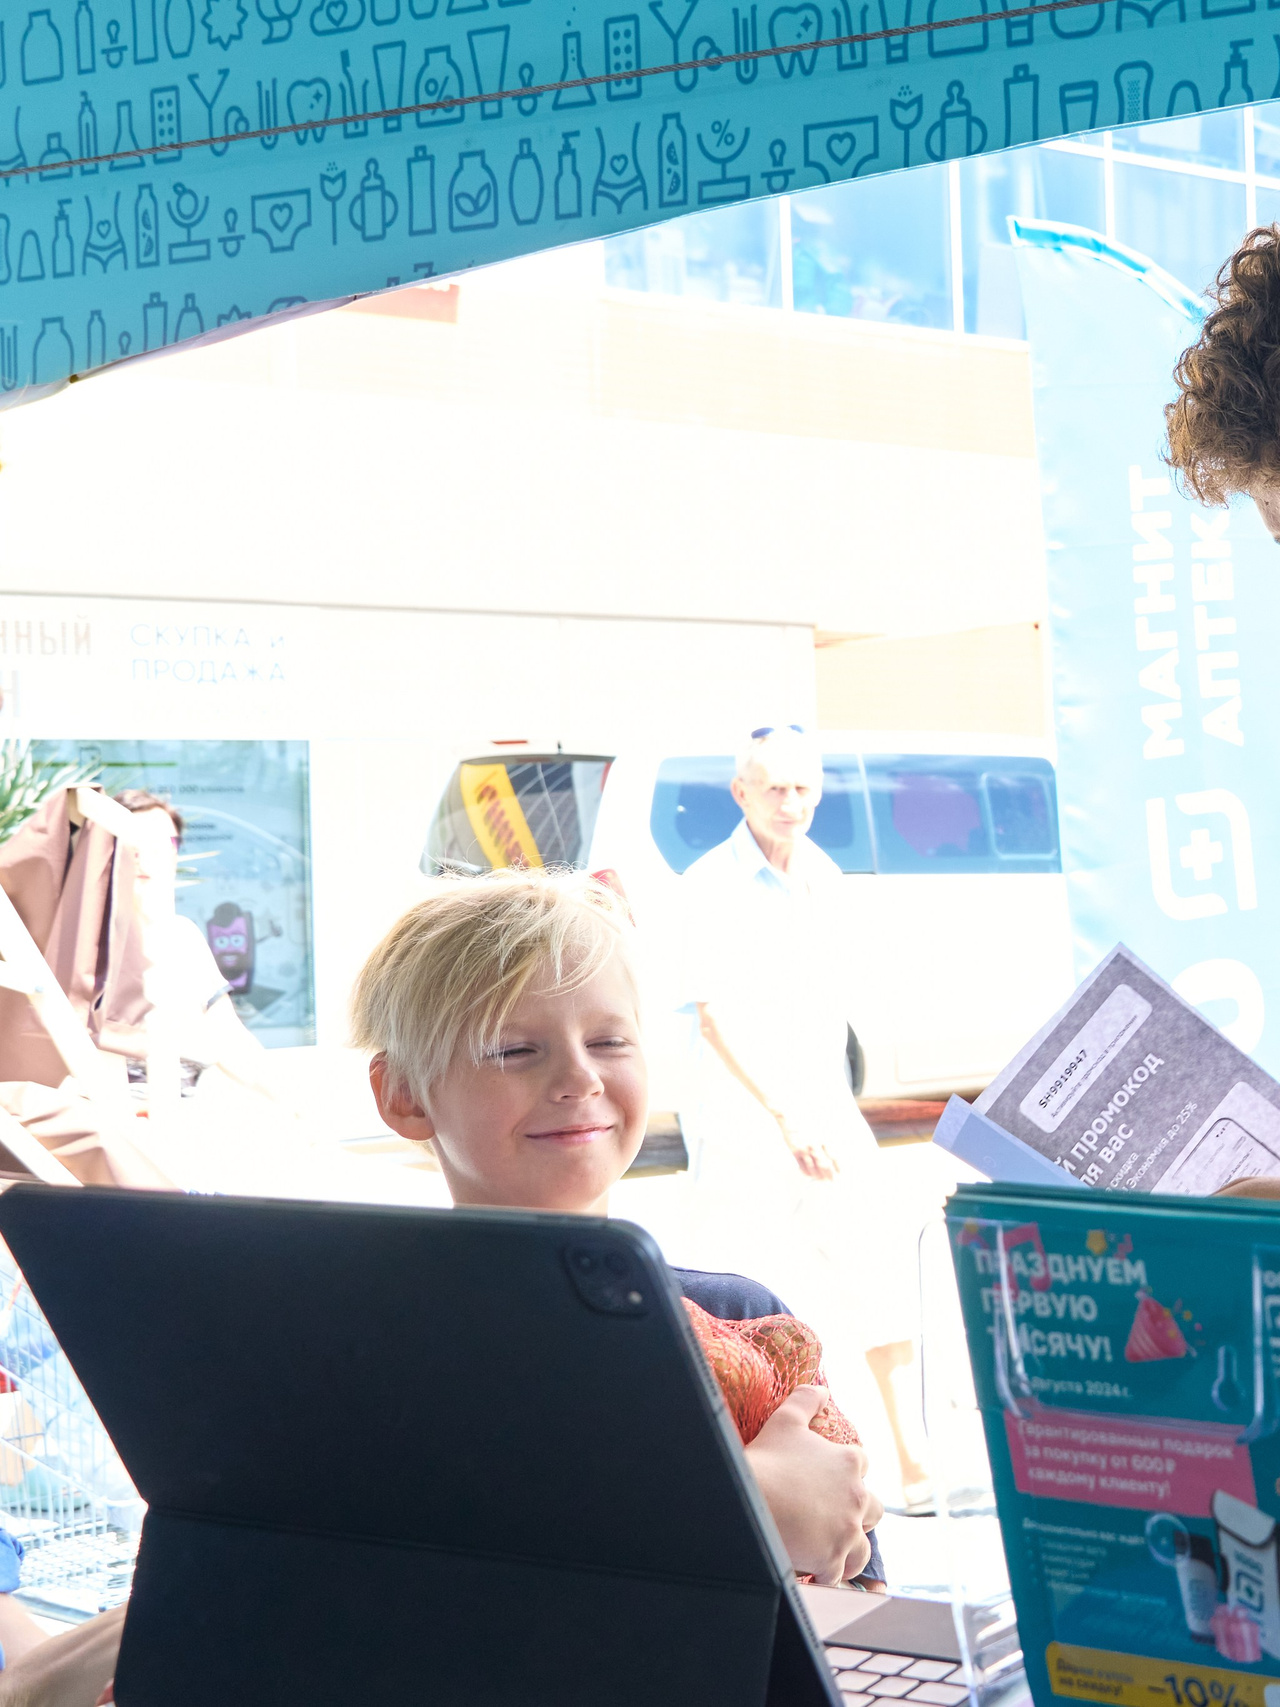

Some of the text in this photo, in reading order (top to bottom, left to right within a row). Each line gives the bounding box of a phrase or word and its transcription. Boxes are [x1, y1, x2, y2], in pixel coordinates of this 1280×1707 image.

[130, 623, 250, 647] СКУПКА
[1128, 464, 1185, 760] МАГНИТ
[1190, 511, 1245, 748] АПТЕК
[132, 659, 286, 684] ПРОДАЖА
[1038, 1049, 1087, 1108] SH9919947
[1054, 1052, 1165, 1173] й промокод
[1166, 1123, 1181, 1141] до
[1176, 1101, 1198, 1126] 25%
[1079, 1123, 1134, 1186] ля вас
[1110, 1152, 1140, 1188] скидка
[986, 1323, 1113, 1362] СЯЧУ!
